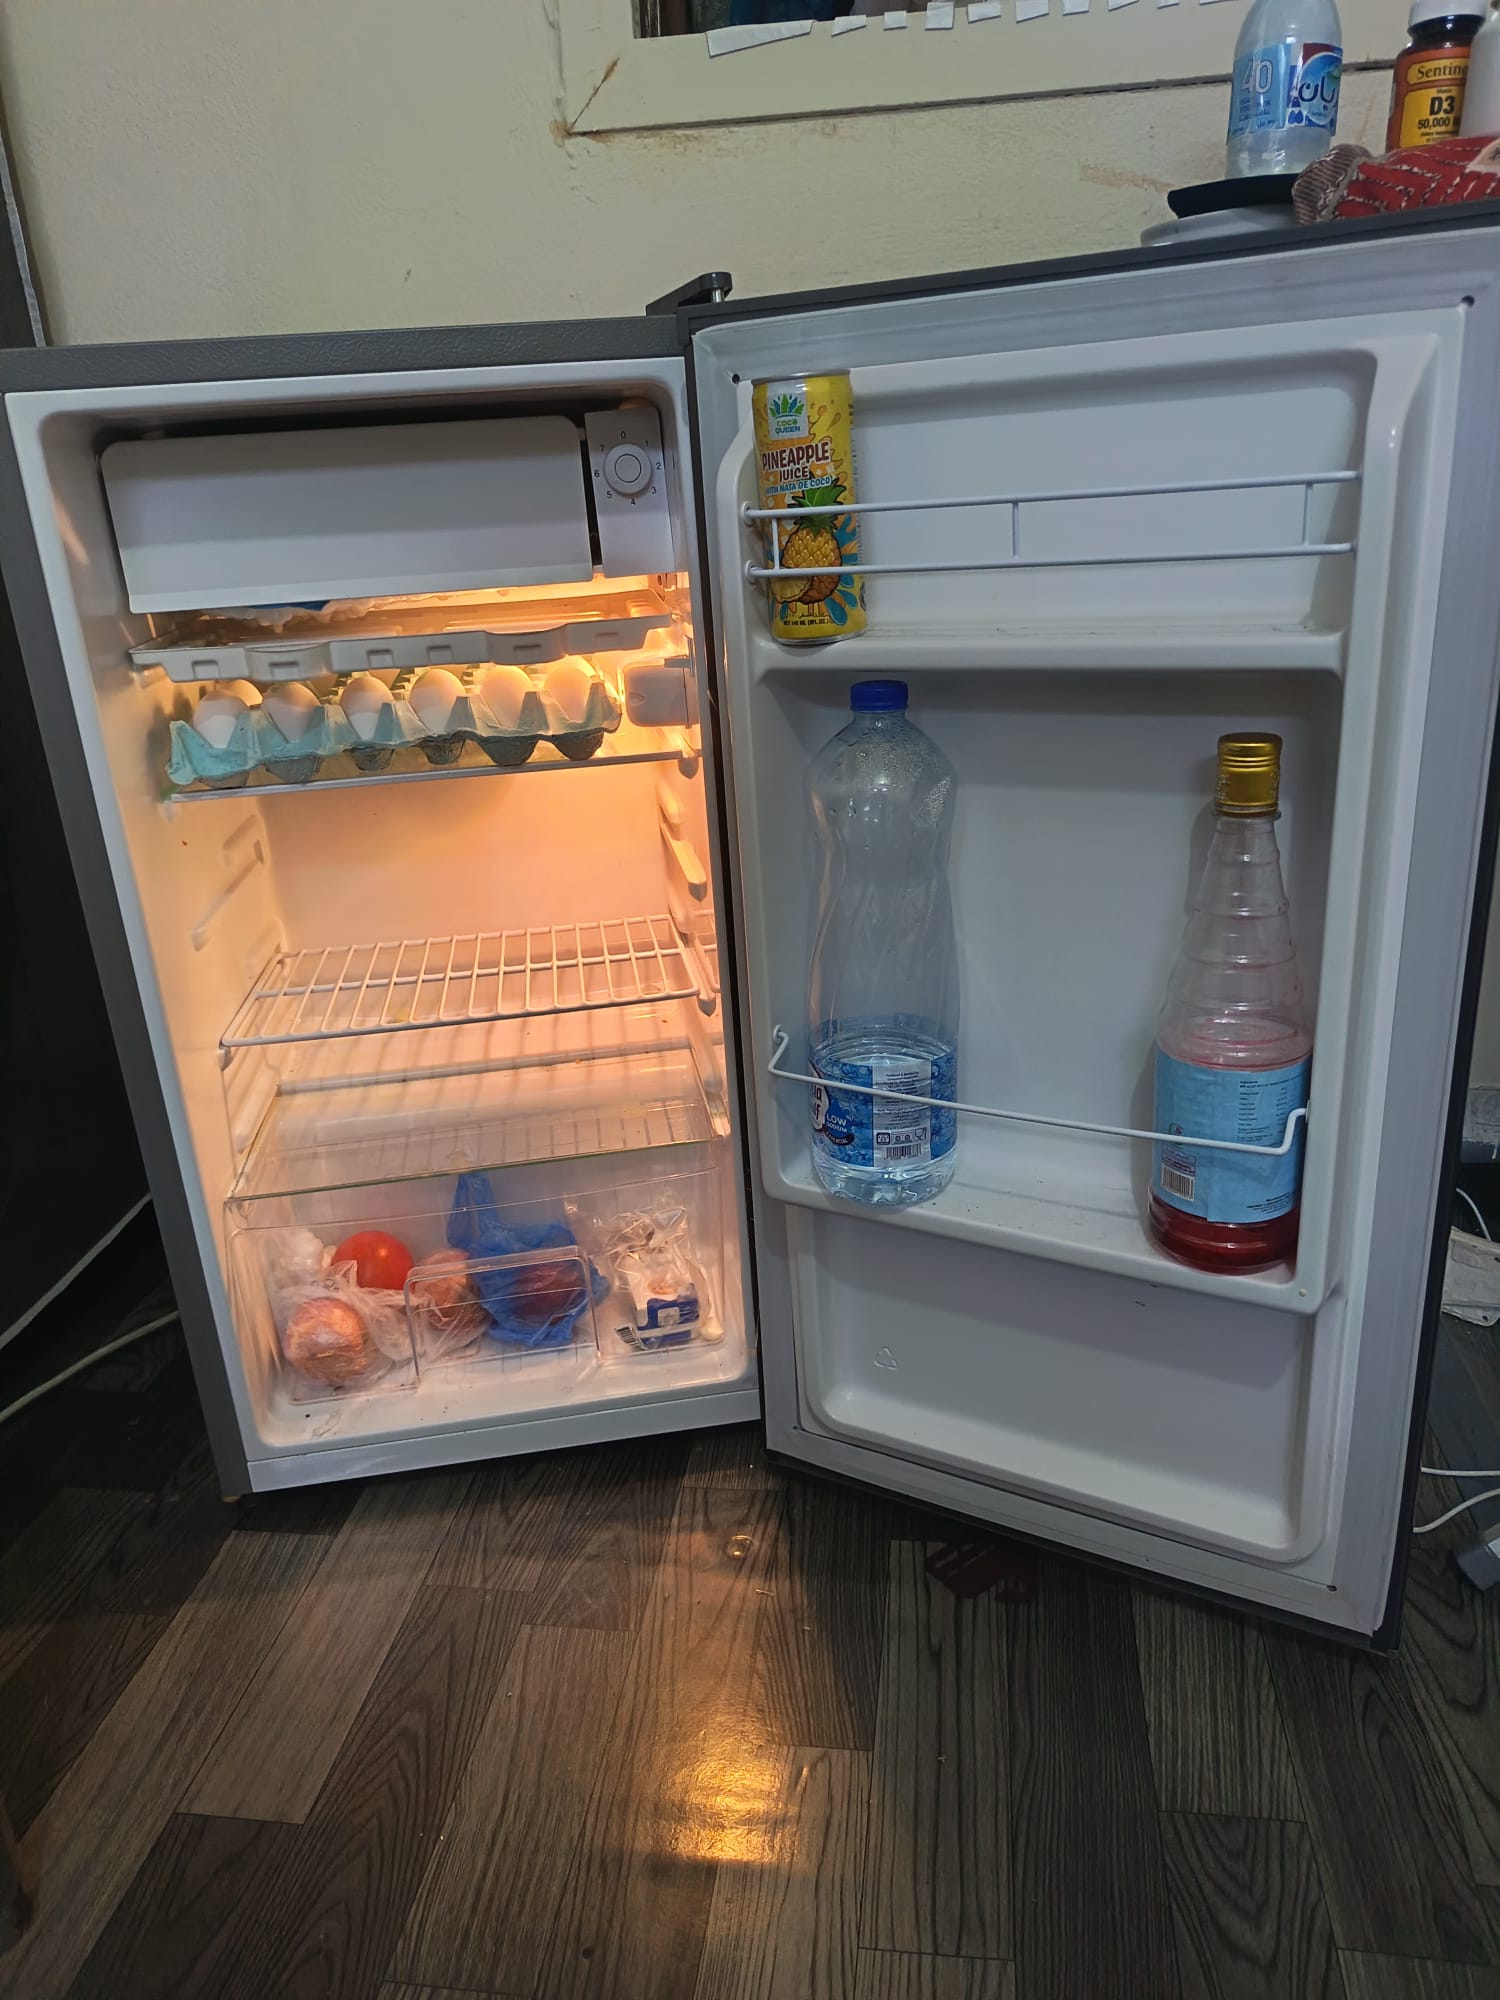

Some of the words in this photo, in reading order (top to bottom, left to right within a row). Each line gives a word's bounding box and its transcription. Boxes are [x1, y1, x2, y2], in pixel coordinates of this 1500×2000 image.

[1298, 75, 1338, 112] يان
[1429, 95, 1456, 116] D3
[1417, 117, 1450, 130] 50,000
[776, 419, 798, 427] COCO
[775, 426, 801, 434] QUEEN
[762, 441, 830, 470] PINEAPPLE
[655, 462, 662, 470] 2
[594, 470, 600, 478] 6
[779, 466, 809, 481] JUICE
[651, 486, 657, 495] 3
[780, 483, 797, 492] NATA
[798, 479, 809, 489] DE
[809, 476, 831, 486] COCO
[606, 490, 613, 499] 5
[826, 1112, 847, 1126] LOW
